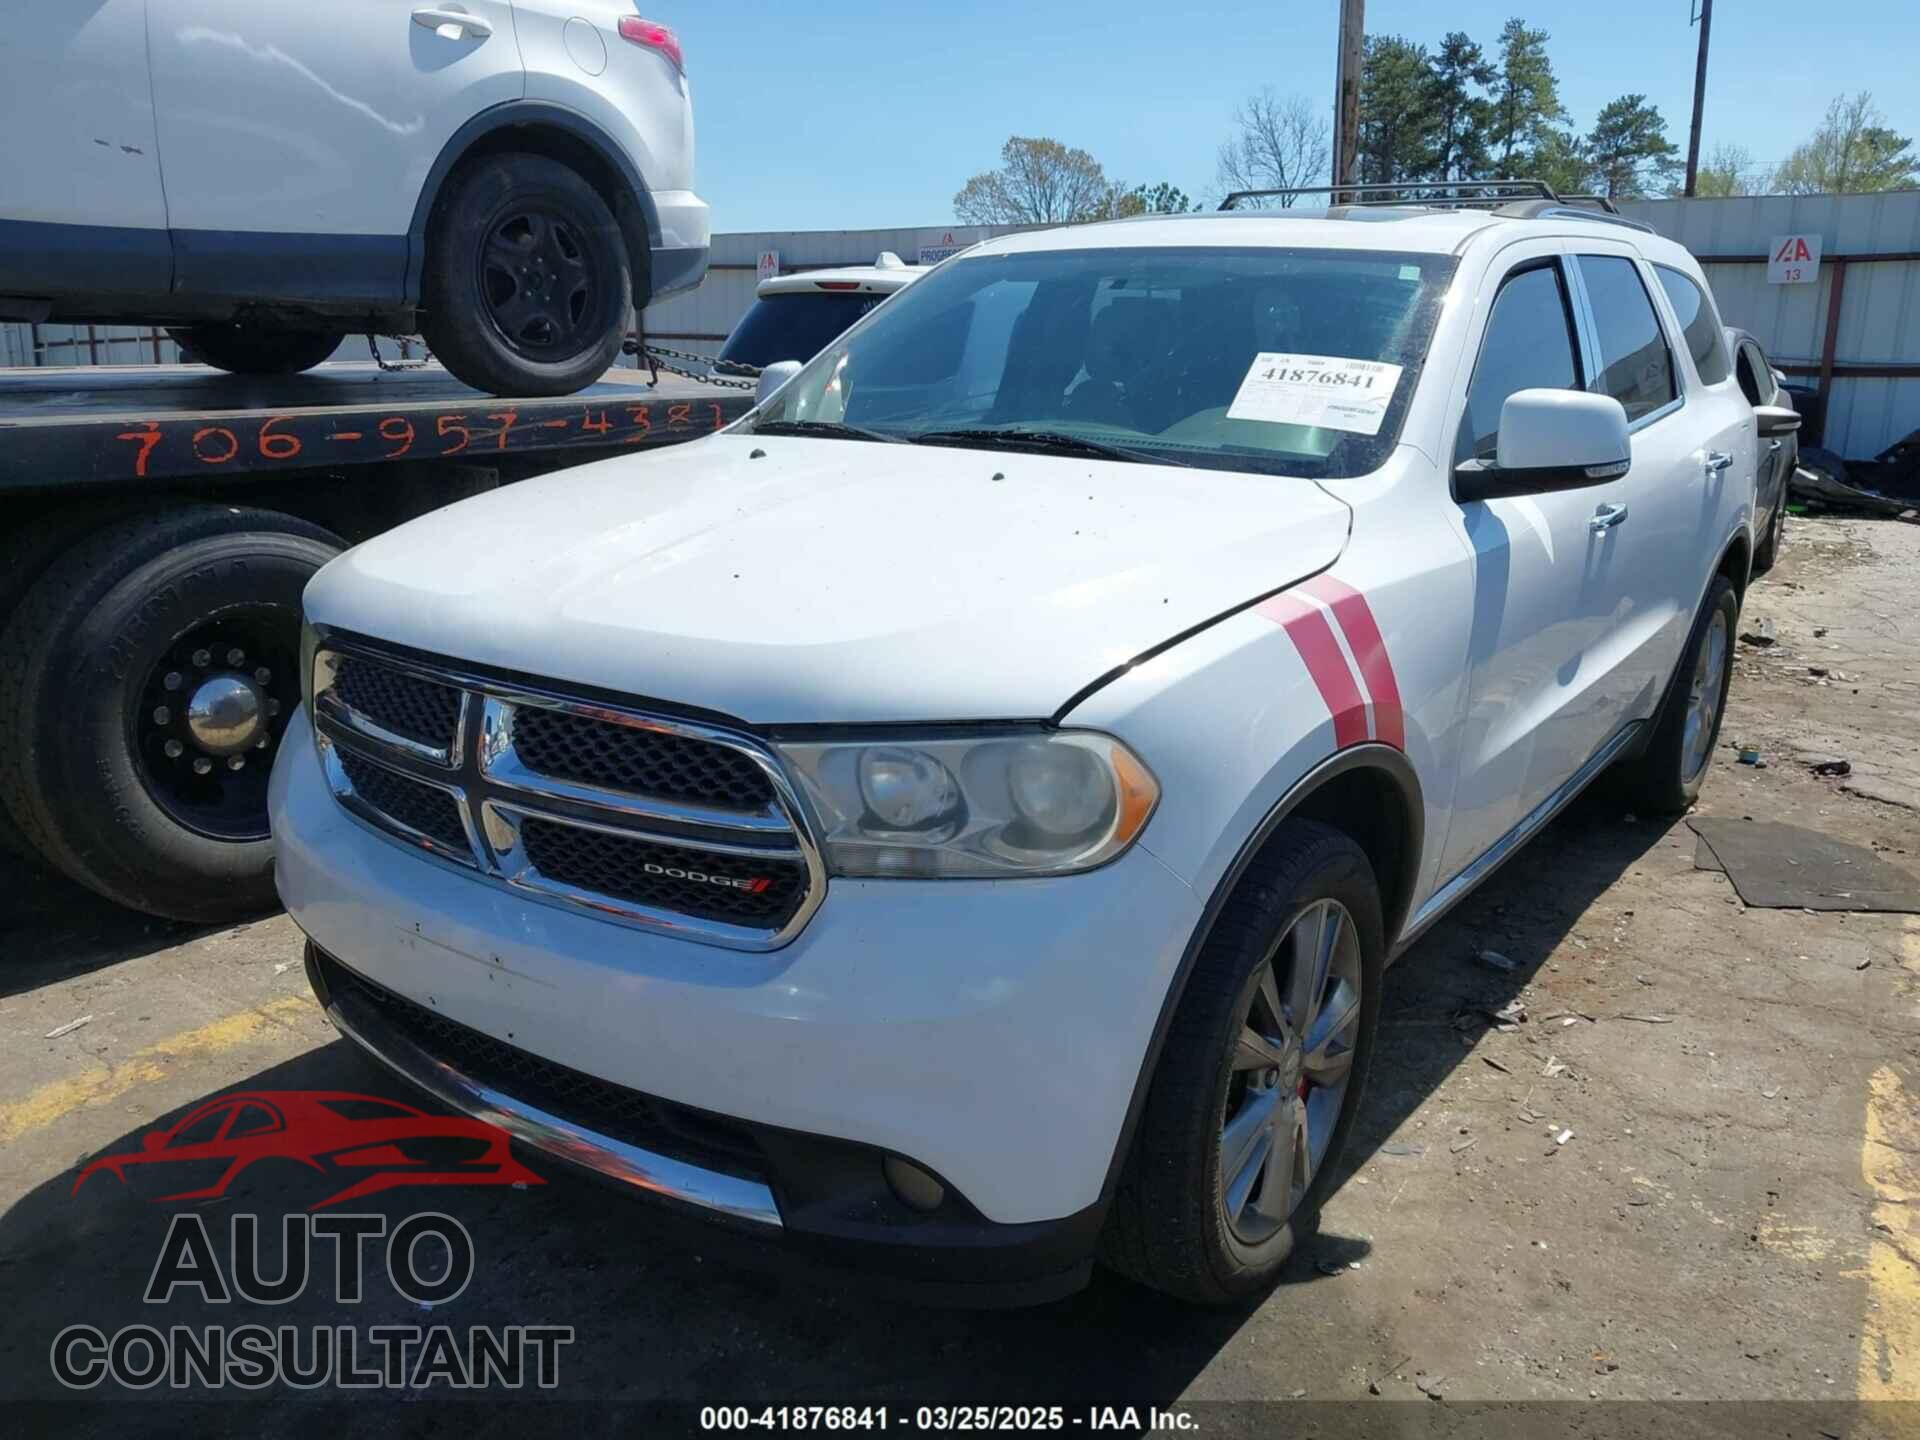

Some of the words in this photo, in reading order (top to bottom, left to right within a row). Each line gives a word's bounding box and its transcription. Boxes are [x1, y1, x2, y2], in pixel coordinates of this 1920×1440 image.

[1784, 269, 1801, 281] 13
[1262, 368, 1374, 388] 41876841
[643, 863, 753, 889] DODGE
